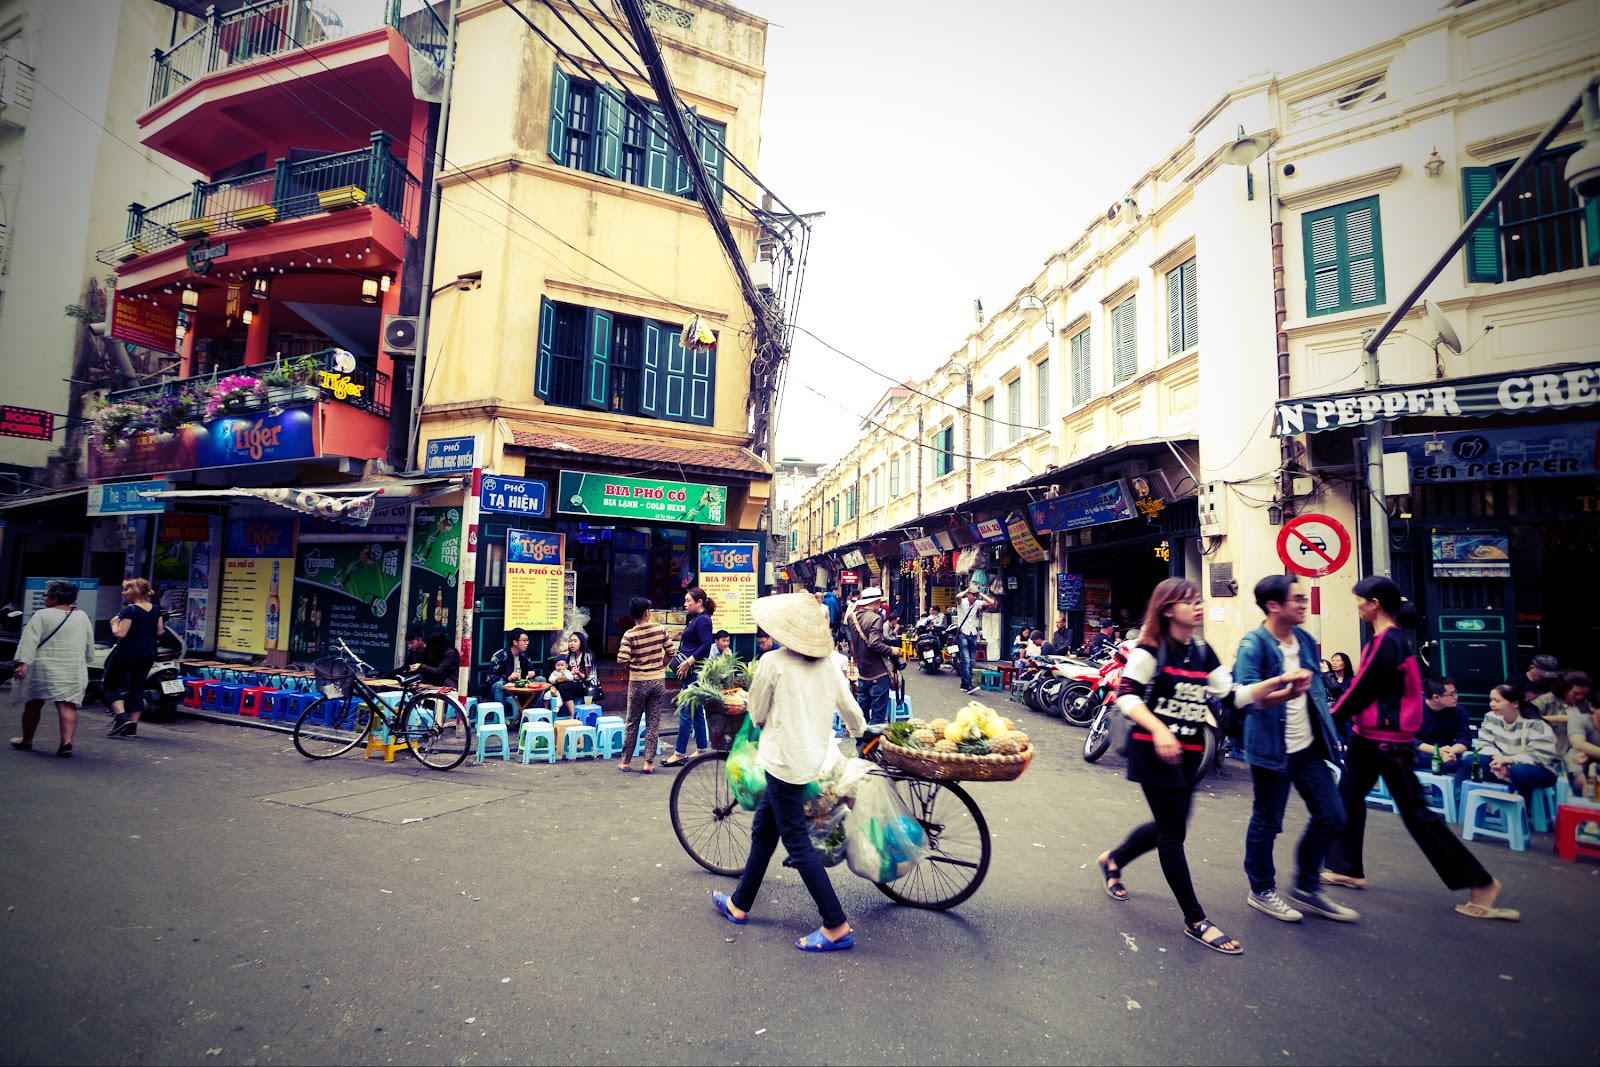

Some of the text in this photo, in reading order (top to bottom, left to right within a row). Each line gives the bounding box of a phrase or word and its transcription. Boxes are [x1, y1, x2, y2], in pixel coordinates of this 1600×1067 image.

[117, 302, 138, 315] BOOK
[320, 370, 364, 399] Tiger
[1312, 386, 1461, 428] PEPPER
[5, 411, 40, 424] BOOK
[0, 422, 43, 435] POSTER
[234, 418, 282, 460] Tiger
[444, 442, 460, 452] PHỐ
[1414, 457, 1580, 480] EEN PEPPER
[106, 486, 120, 504] The
[122, 485, 140, 503] Sinh
[504, 484, 526, 493] PHỐ
[605, 484, 630, 497] BIA
[634, 486, 664, 500] PHỐ
[489, 494, 538, 512] TẠ HIỆN
[603, 498, 616, 506] BIA
[618, 500, 638, 508] LẠNH
[646, 502, 665, 510] COLD
[667, 504, 686, 512] BEER
[1136, 497, 1164, 518] Tiger
[708, 514, 721, 522] FUN
[980, 525, 992, 534] BIA
[244, 523, 282, 554] Tiger
[442, 536, 458, 547] OPEN
[384, 548, 398, 558] OPEN
[442, 546, 458, 556] FOR
[520, 538, 558, 560] Tiger
[1154, 547, 1169, 562] Tig
[307, 557, 335, 568] TUBORG
[383, 557, 397, 567] FOR
[440, 555, 458, 568] FUN
[710, 550, 750, 570] Tiger
[382, 566, 396, 576] FUN
[528, 566, 548, 575] PHỐ
[722, 574, 738, 582] PHỐ
